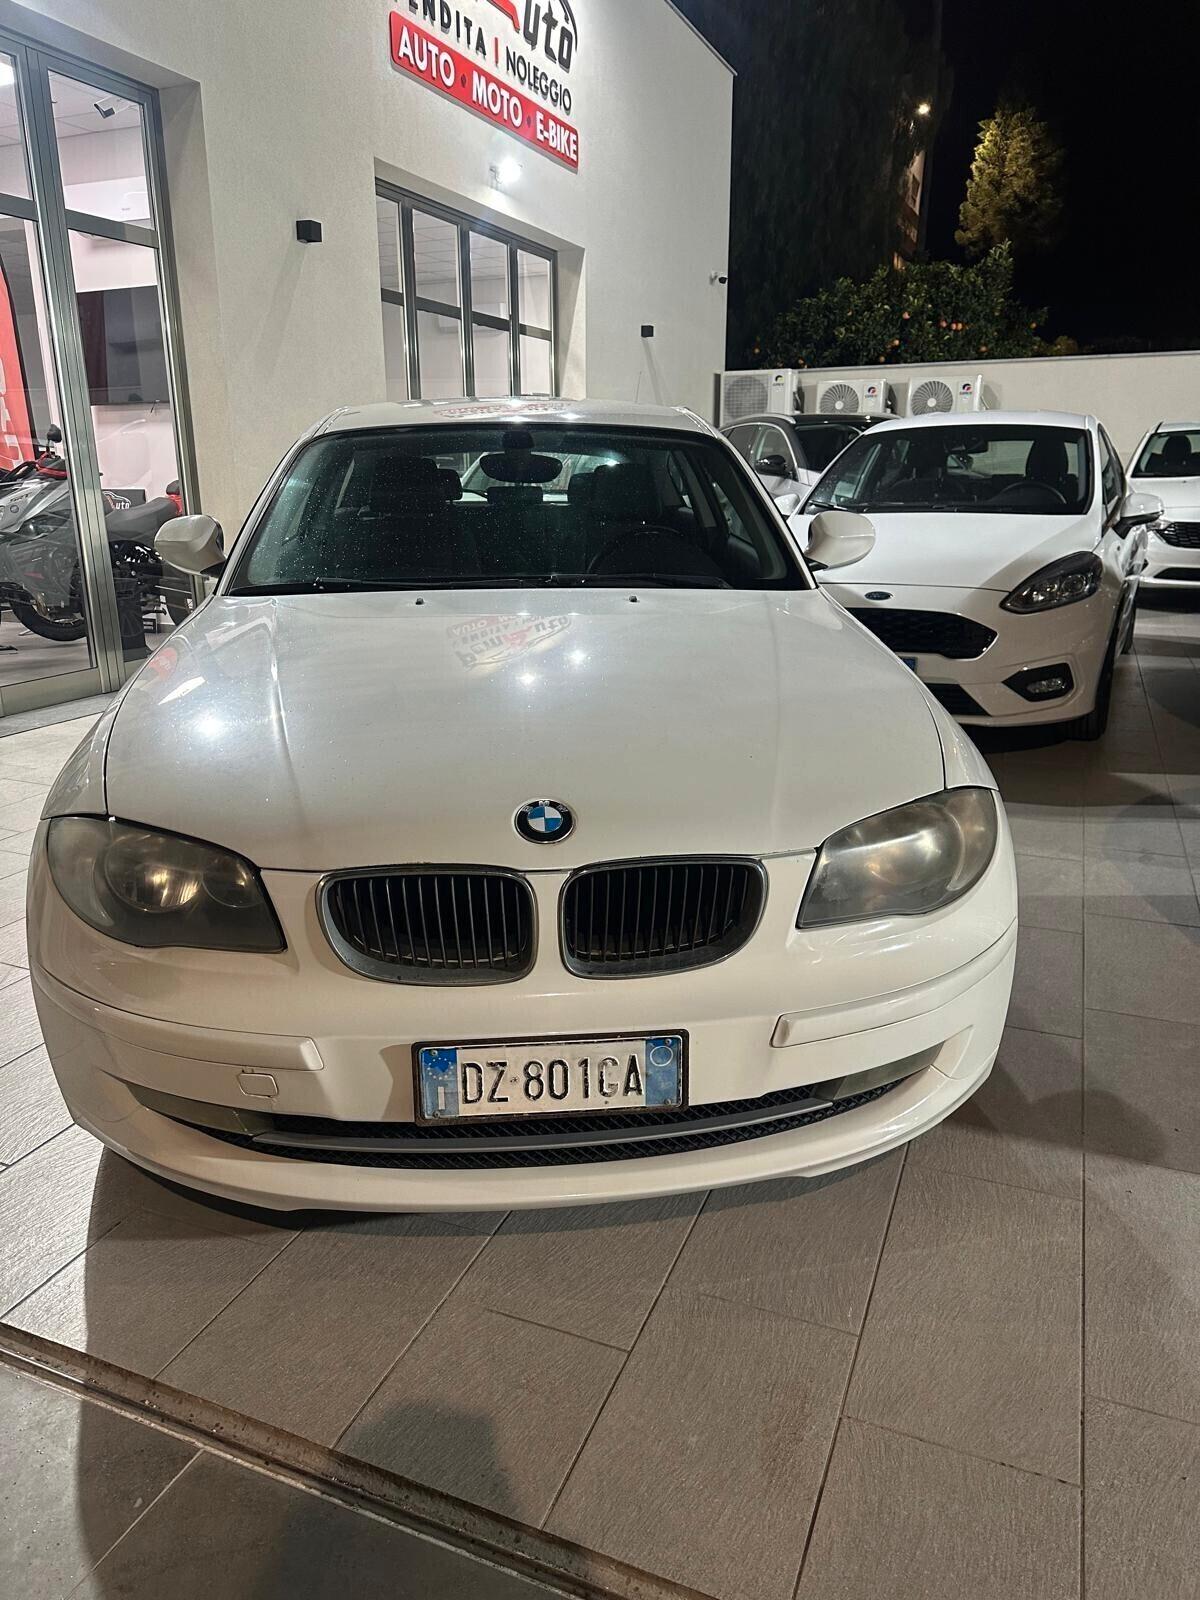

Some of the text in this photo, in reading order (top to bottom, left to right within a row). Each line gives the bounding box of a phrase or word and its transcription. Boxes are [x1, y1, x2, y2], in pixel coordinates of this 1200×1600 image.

[399, 25, 577, 161] AUTO MOTO E-BIKE
[506, 46, 571, 111] NOLEGGIO
[461, 1061, 509, 1104] DZ
